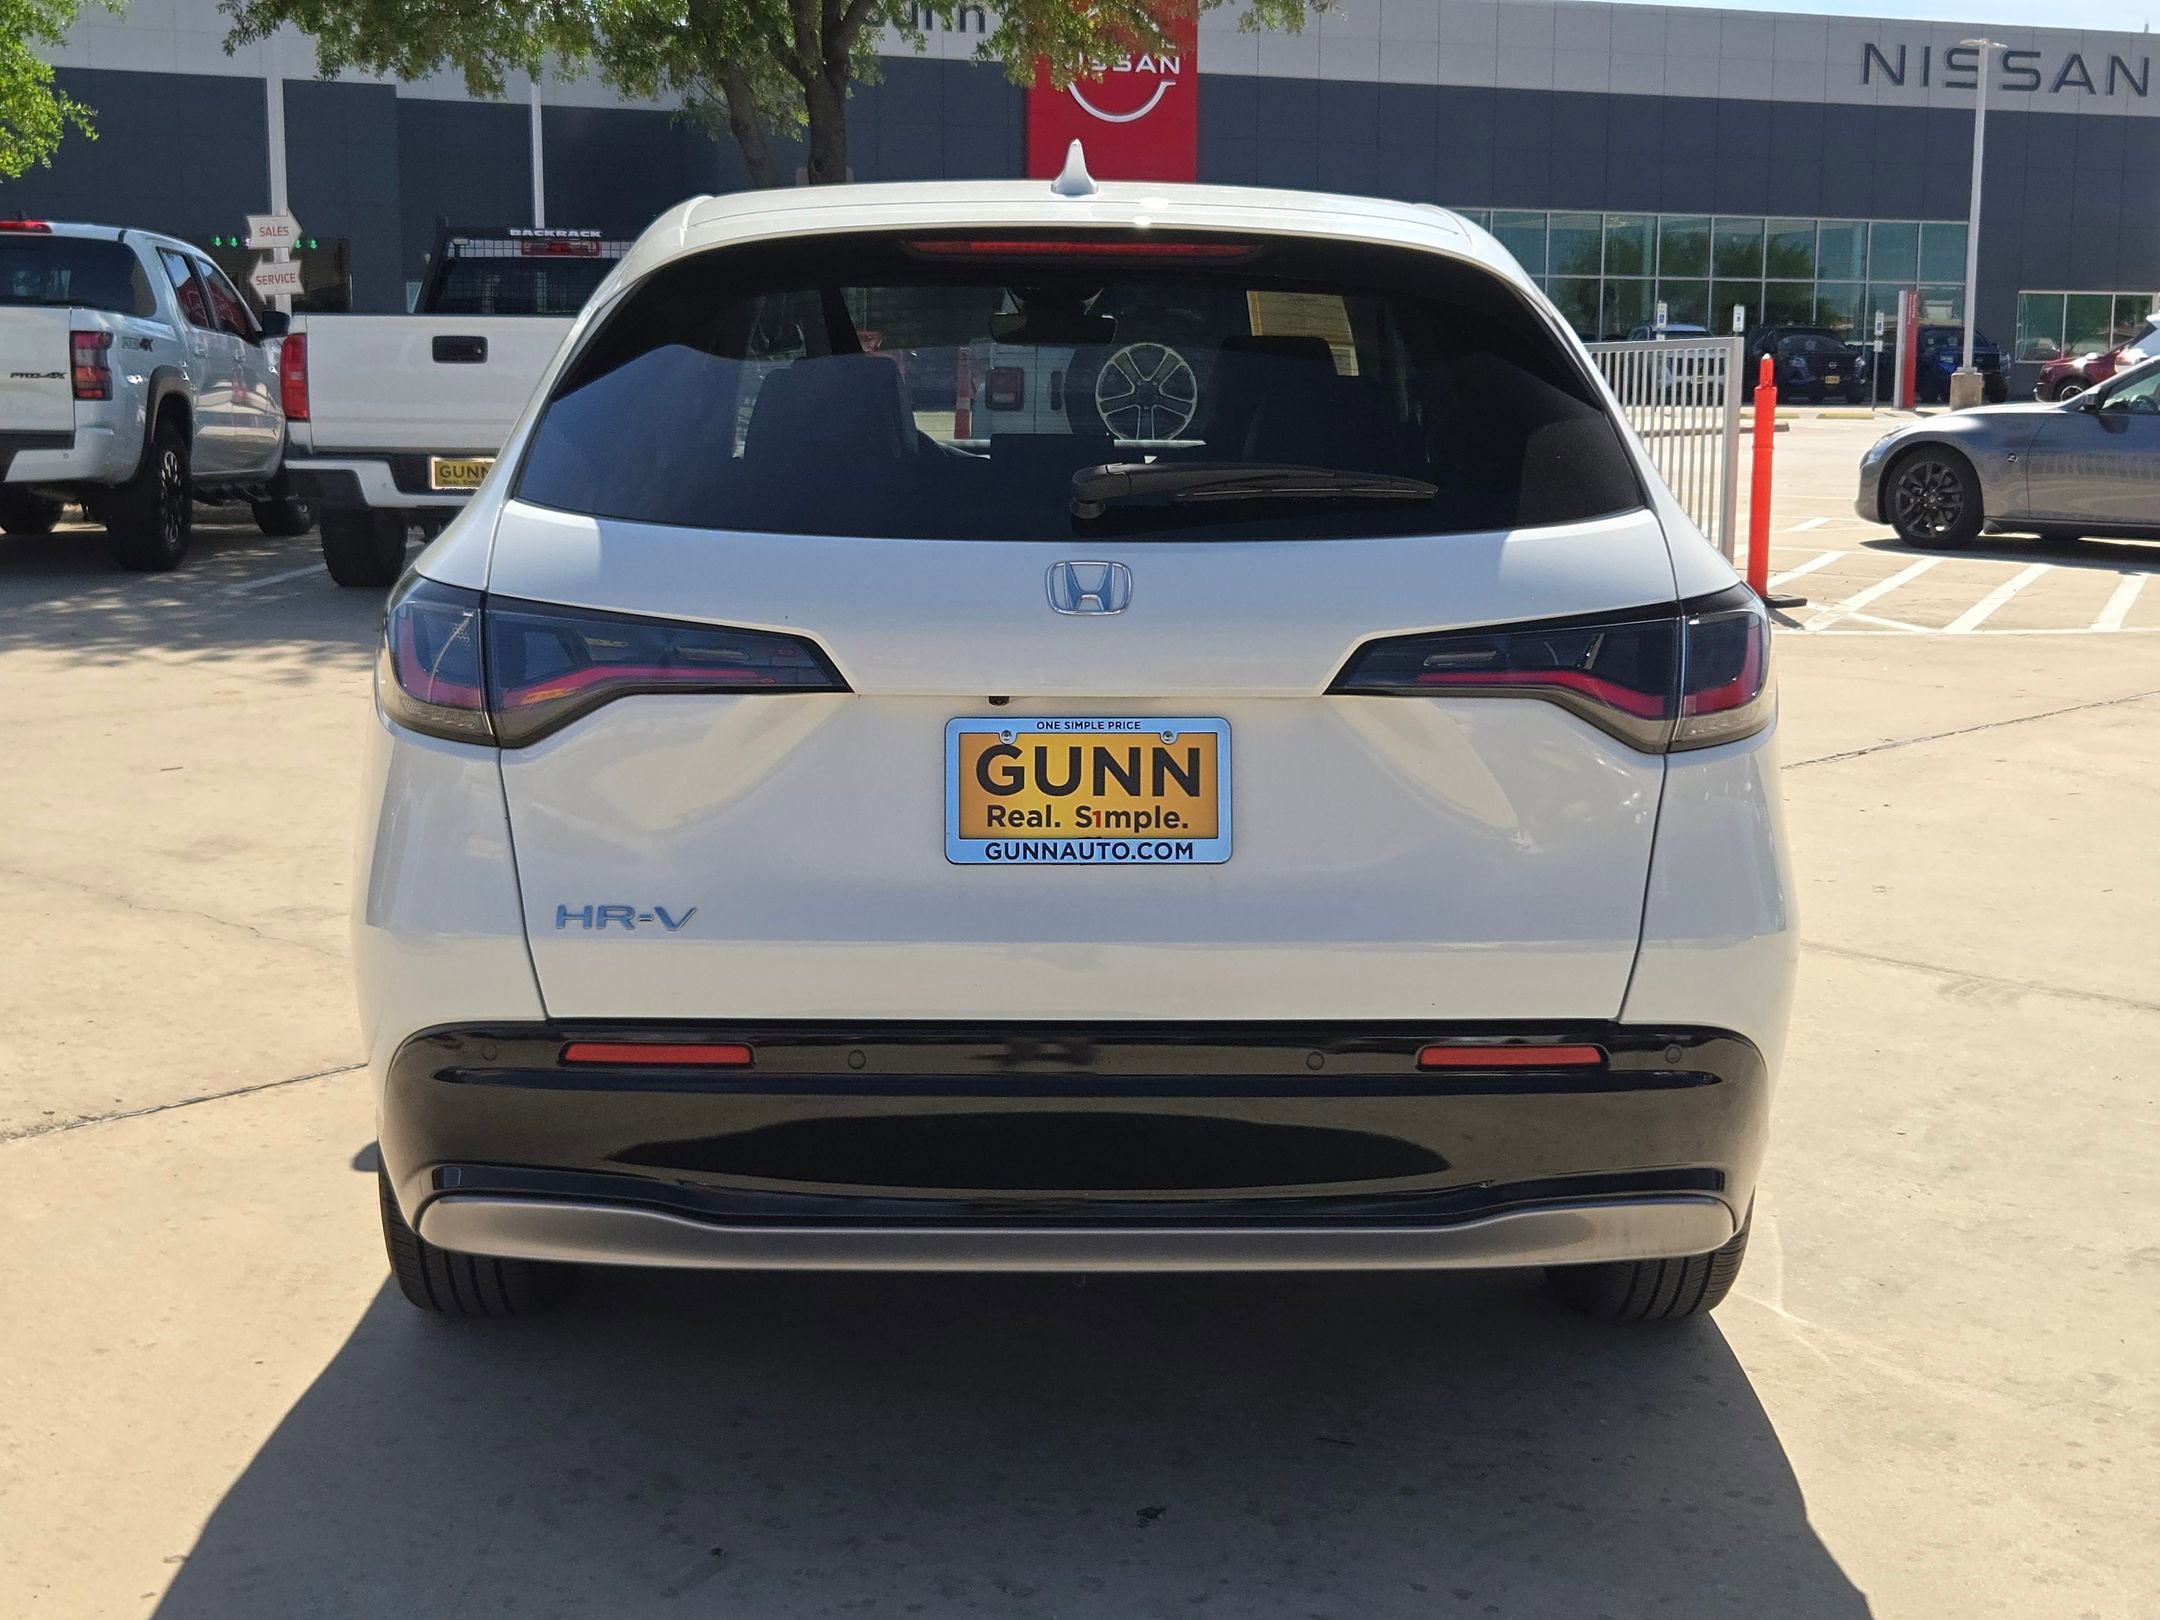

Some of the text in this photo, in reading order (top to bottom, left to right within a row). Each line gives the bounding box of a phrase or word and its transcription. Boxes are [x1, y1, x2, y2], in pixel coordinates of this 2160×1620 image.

[1860, 42, 2150, 97] NISSAN
[259, 226, 289, 237] SALES
[509, 229, 602, 238] BACKRACK
[255, 273, 296, 286] SERVICE
[1036, 721, 1141, 730] ONE SIMPLE PRICE
[975, 744, 1201, 797] GUNN
[986, 805, 1061, 828] Real.
[985, 842, 1194, 861] GUNNAUTO.COM
[555, 904, 698, 931] HR-V
